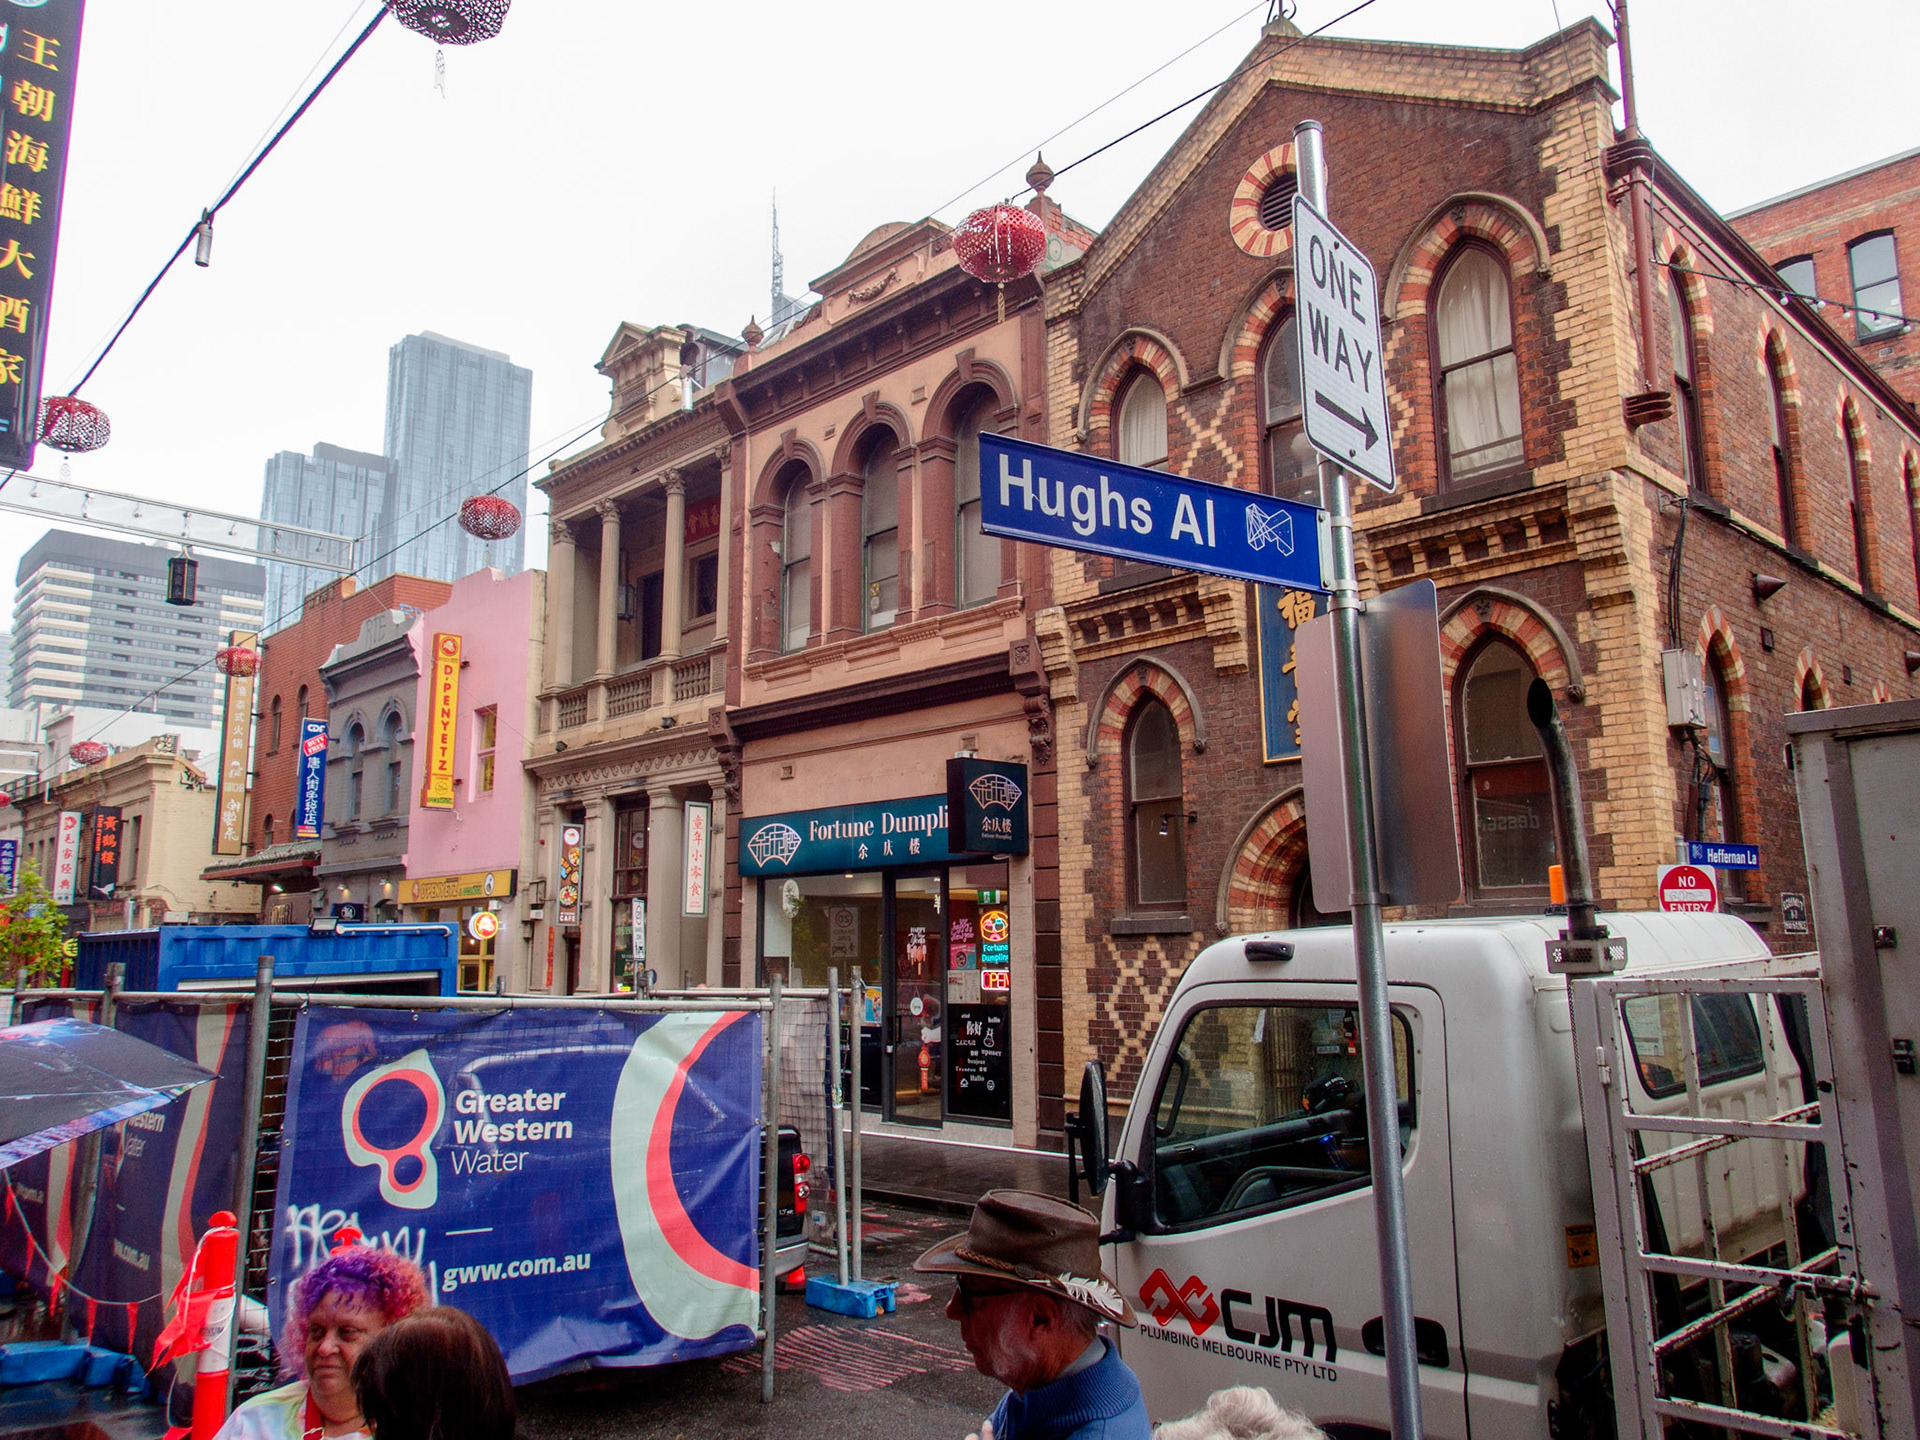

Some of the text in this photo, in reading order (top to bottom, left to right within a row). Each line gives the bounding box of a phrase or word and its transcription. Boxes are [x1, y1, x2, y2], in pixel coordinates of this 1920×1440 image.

[0, 29, 61, 384] 王朝海鮮大酒家
[1310, 234, 1367, 326] ONE
[1307, 301, 1373, 395] WAY
[999, 453, 1216, 547] Hughs Al
[438, 664, 453, 771] D'PENYETZ
[307, 735, 325, 748] DUTY
[308, 742, 326, 755] FREE
[304, 757, 321, 825] 唐人街免税店
[809, 819, 875, 842] Fortune
[982, 816, 1012, 833] 余庆楼
[690, 814, 704, 897] 童年小零食
[858, 838, 920, 860] 余庆楼
[1707, 848, 1757, 865] Heffernan La
[1678, 875, 1696, 887] NO
[559, 914, 576, 922] CAFE
[1669, 902, 1709, 912] ENTRY
[983, 944, 1009, 952] Fortune
[983, 973, 1009, 988] OPEN
[967, 1021, 983, 1036] 你好
[455, 1088, 566, 1115] Greater
[453, 1117, 574, 1145] Western
[451, 1148, 530, 1175] Water
[442, 1253, 591, 1292] gww.com.au
[1140, 1324, 1337, 1382] PLUMBING MELBOURNE PTY LTD
